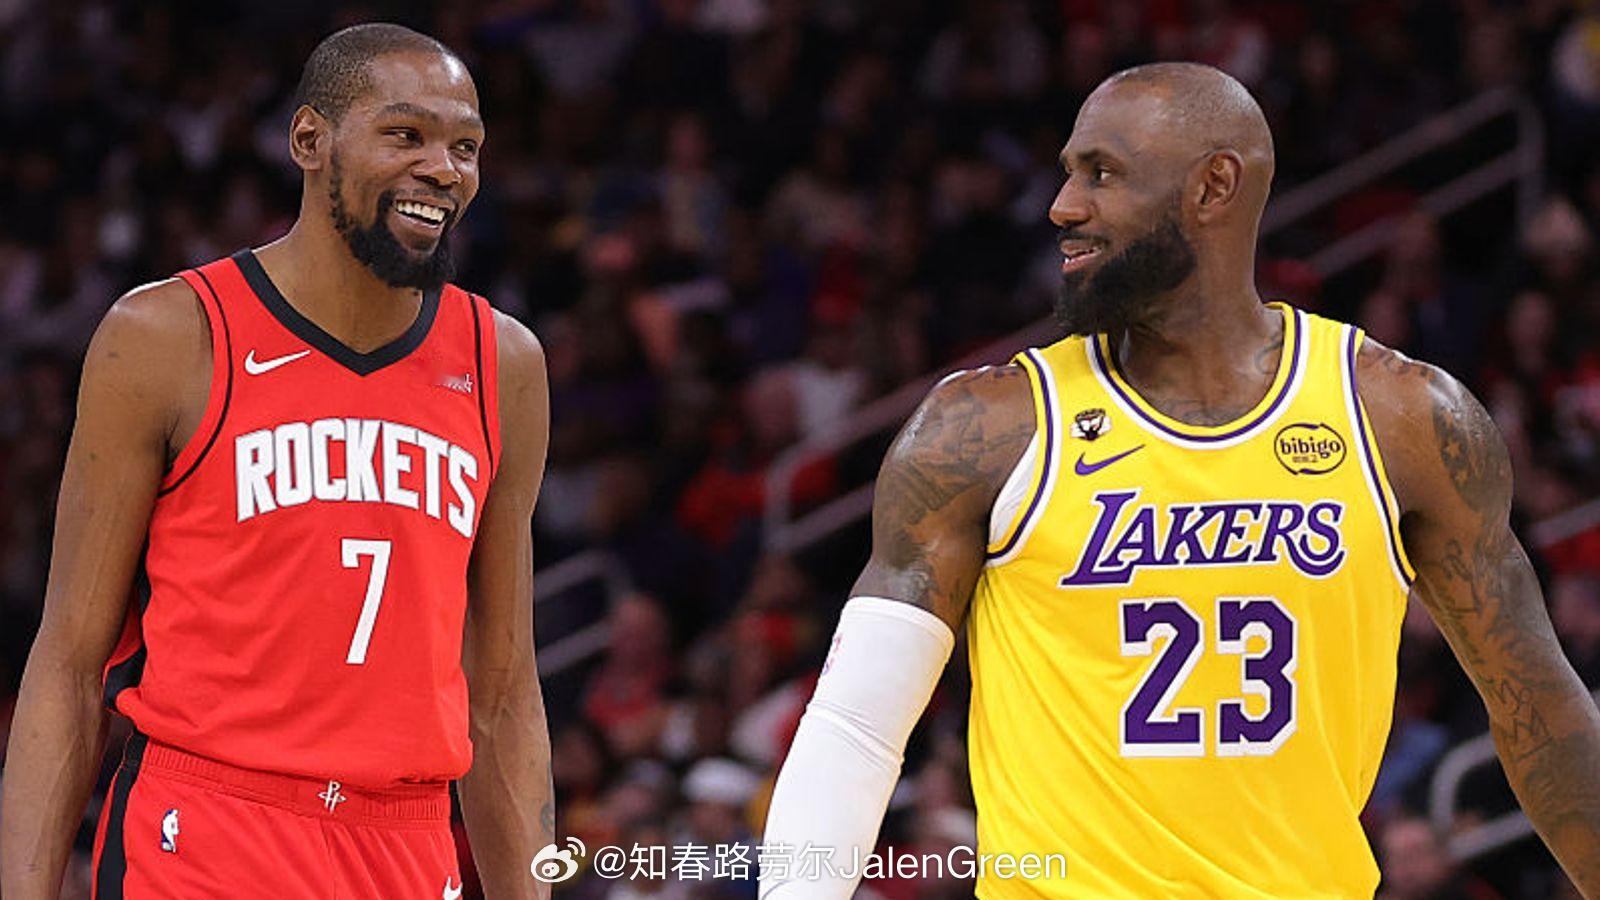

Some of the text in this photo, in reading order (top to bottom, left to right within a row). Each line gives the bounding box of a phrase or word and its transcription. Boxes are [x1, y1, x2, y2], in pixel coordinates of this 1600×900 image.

[235, 418, 478, 539] ROCKETS
[1280, 436, 1341, 459] bibigo
[1059, 487, 1346, 588] LAKERS
[340, 538, 392, 664] 7
[1119, 596, 1298, 758] 23
